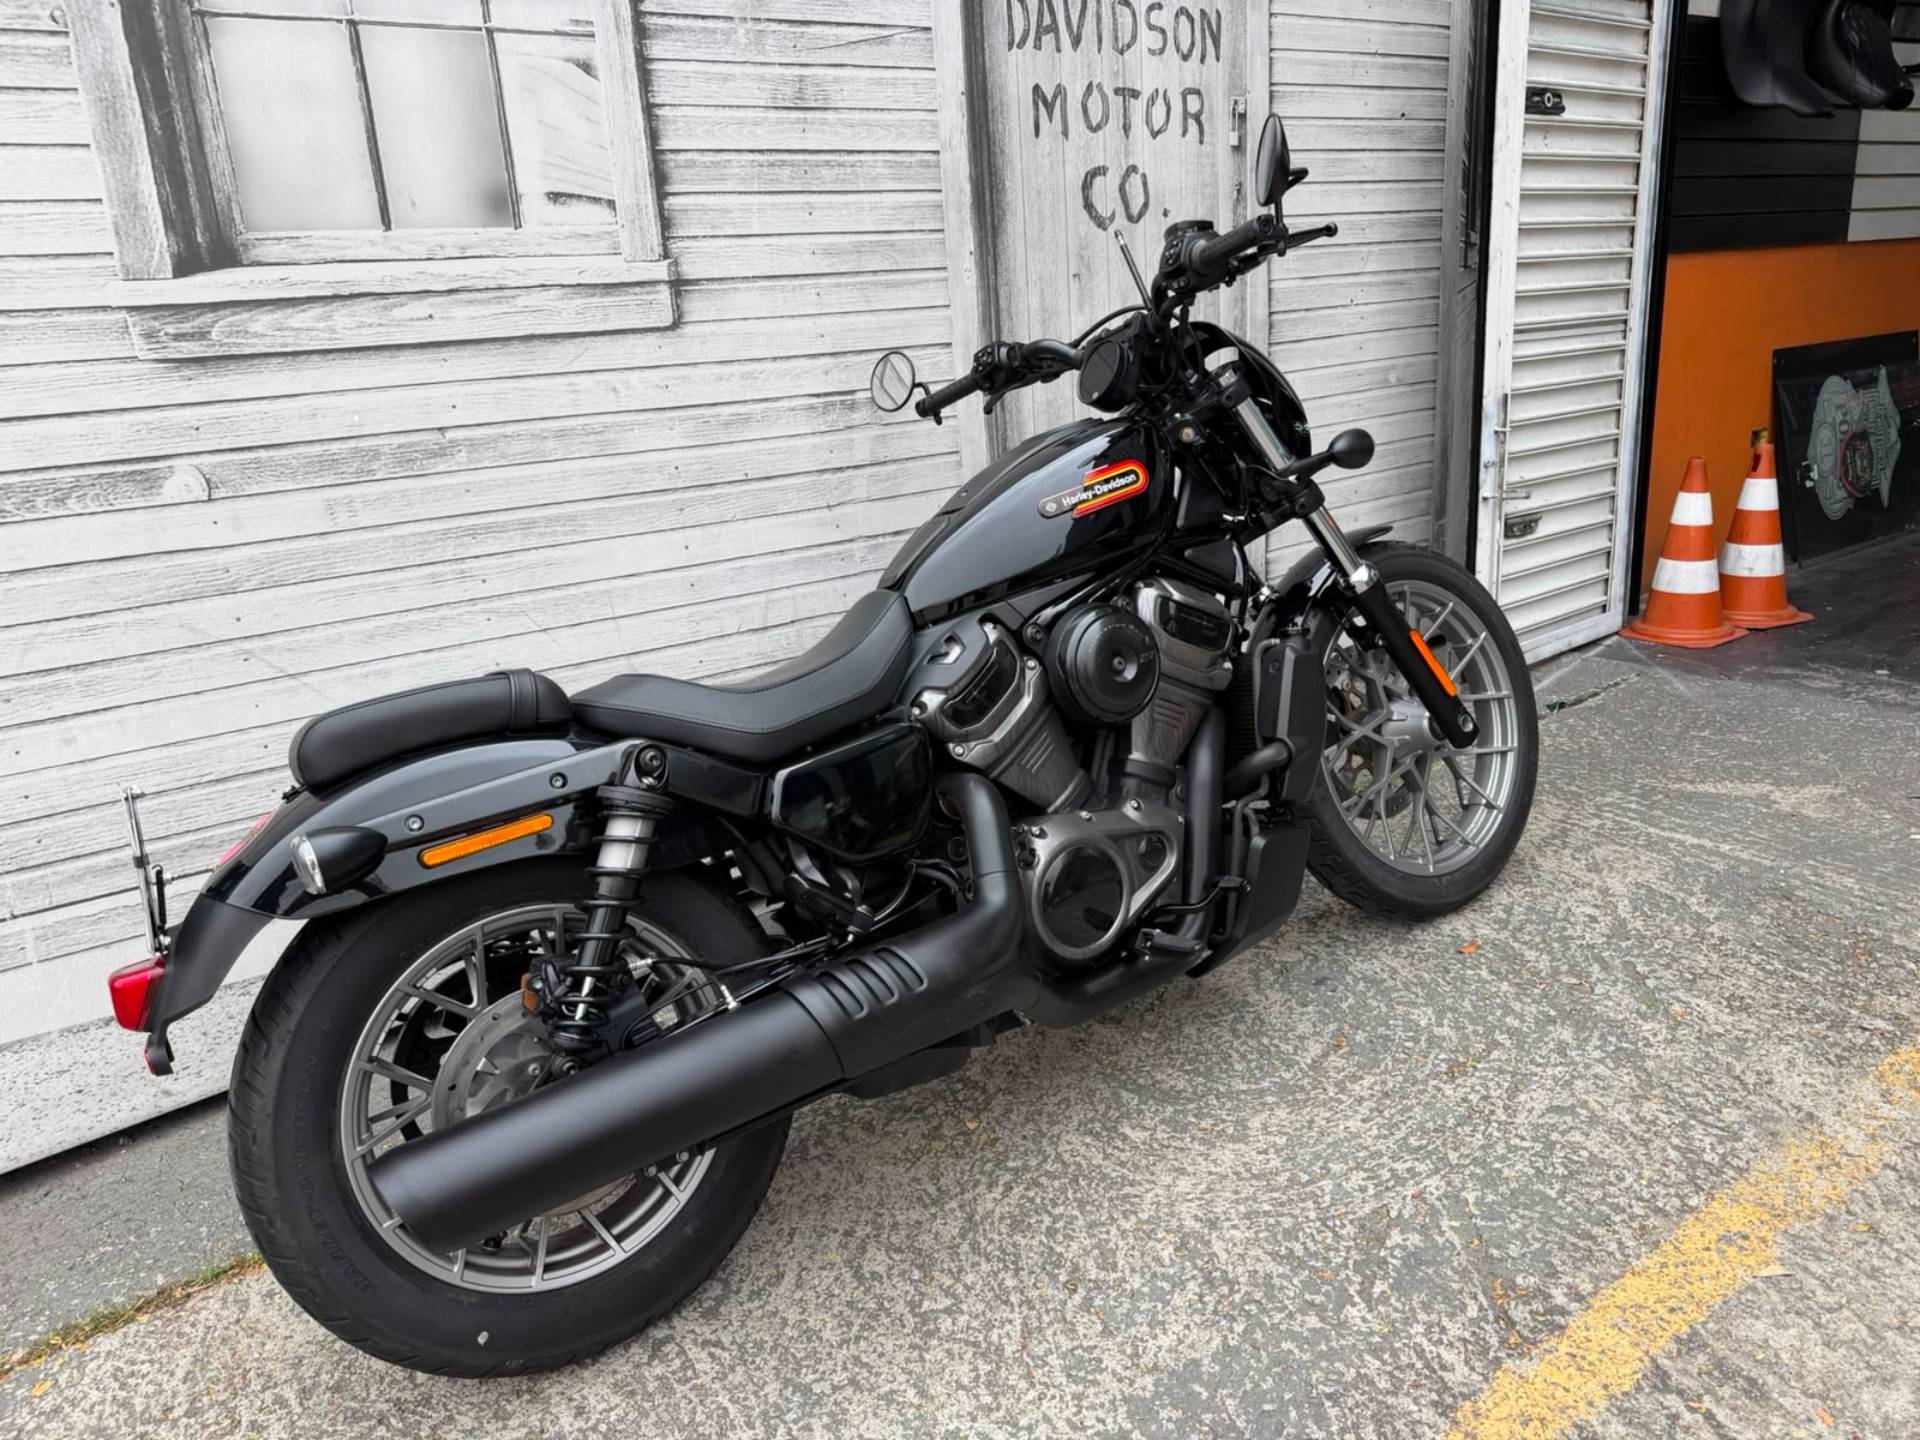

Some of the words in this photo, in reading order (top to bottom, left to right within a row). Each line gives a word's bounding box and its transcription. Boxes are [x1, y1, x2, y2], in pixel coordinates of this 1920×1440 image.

[1007, 0, 1222, 64] DAVIDSON
[1031, 80, 1205, 145] MOTOR
[1081, 163, 1171, 232] CO.
[1061, 473, 1137, 507] Harley-Davidson
